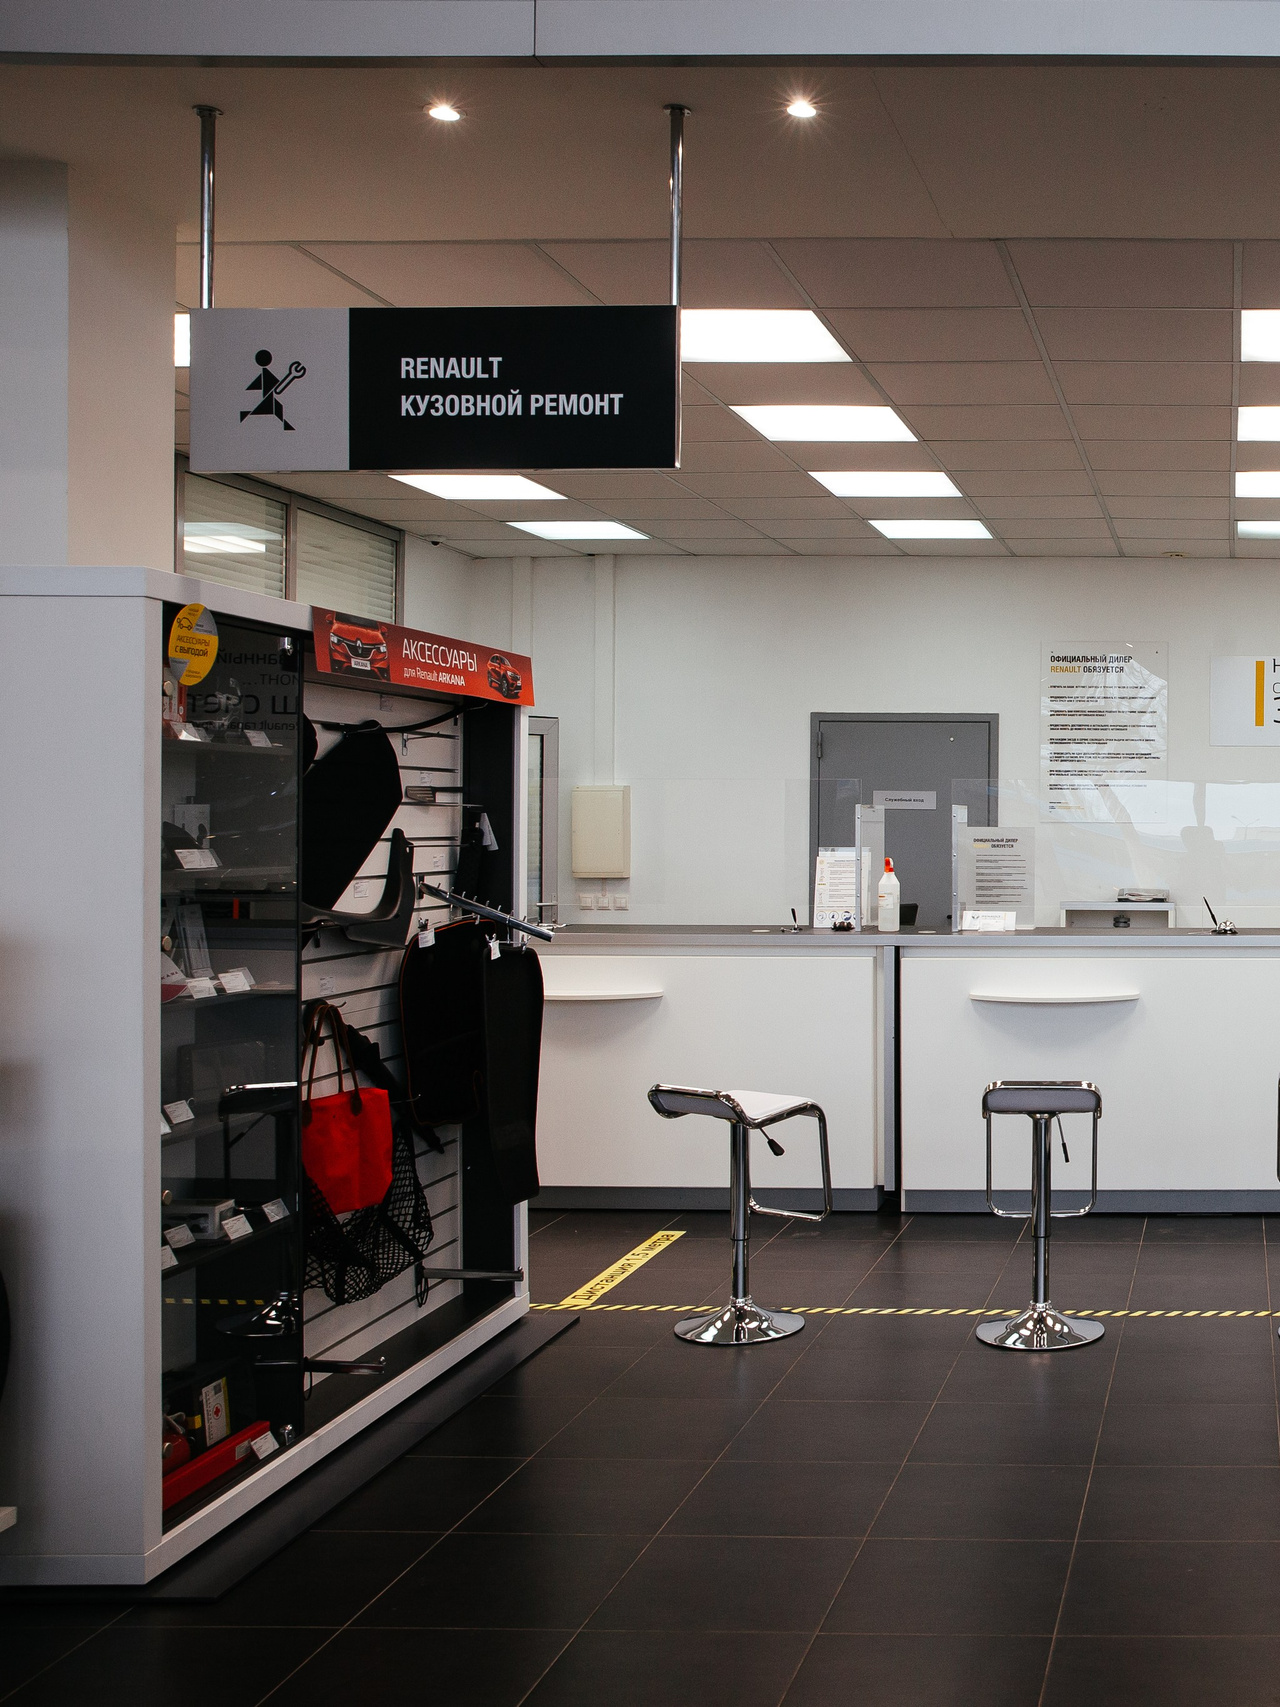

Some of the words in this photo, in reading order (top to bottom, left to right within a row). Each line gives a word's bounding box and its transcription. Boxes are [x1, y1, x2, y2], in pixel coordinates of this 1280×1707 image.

[400, 356, 503, 379] RENAULT
[400, 389, 523, 417] КУЗОВНОЙ
[530, 393, 624, 416] РЕМОНТ
[402, 637, 478, 672] АКСЕССУАРЫ
[1050, 654, 1107, 664] ОФИЦИАЛЬНЫЙ
[1108, 655, 1133, 664] ДИЛЕР
[403, 667, 416, 679] для
[416, 667, 438, 682] Renault
[438, 674, 466, 687] ARKANA
[1050, 665, 1081, 673] RENAULT
[1083, 665, 1124, 673] ОБЯЗУЕТСЯ
[571, 1261, 637, 1301] Дистанция
[641, 1234, 675, 1252] метра
